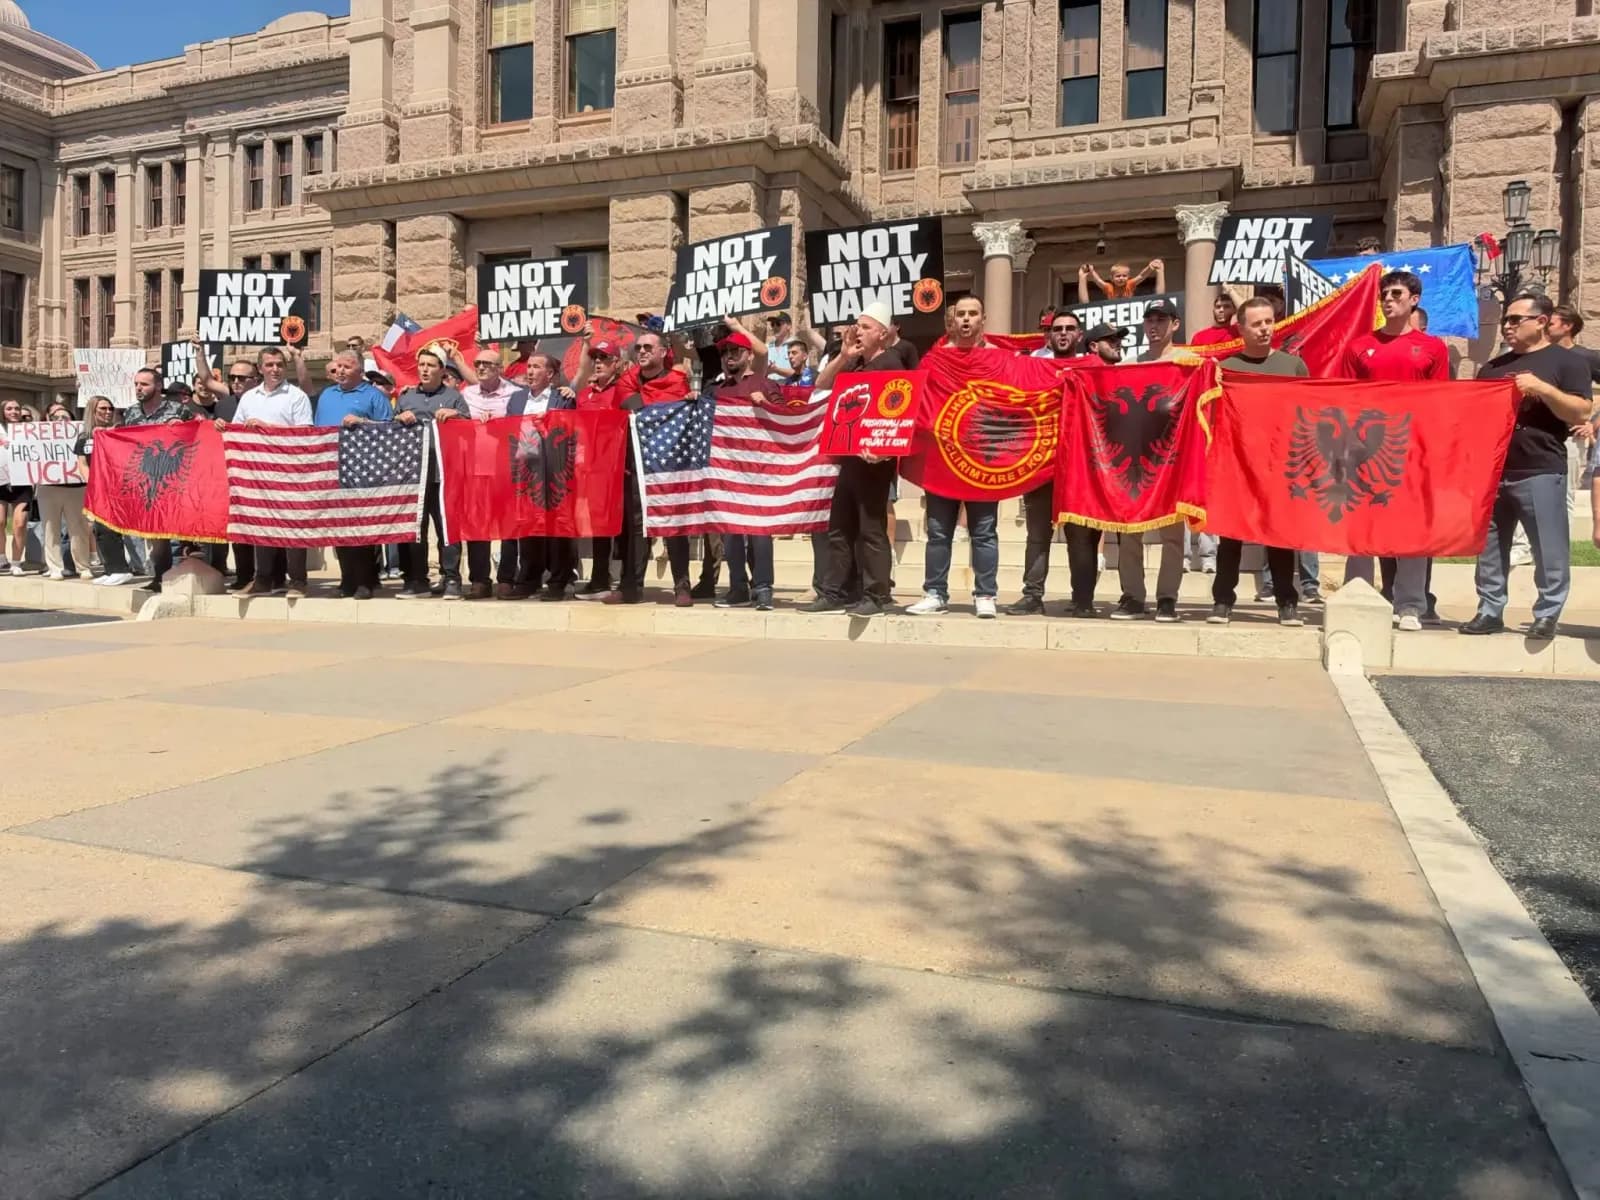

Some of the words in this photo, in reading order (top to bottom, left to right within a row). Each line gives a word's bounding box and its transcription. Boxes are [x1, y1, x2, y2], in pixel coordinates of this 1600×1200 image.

[827, 223, 919, 263] NOT
[1235, 217, 1312, 240] NOT
[693, 231, 770, 271] NOT
[1223, 239, 1258, 259] IN
[1260, 239, 1314, 260] MY
[216, 273, 291, 296] NOT
[494, 260, 569, 290] NOT
[685, 266, 719, 296] IN
[725, 255, 777, 287] MY
[820, 261, 861, 291] IN
[868, 253, 928, 286] MY
[208, 295, 241, 317] IN
[247, 296, 296, 317] MY
[487, 289, 520, 313] IN
[526, 284, 576, 310] MY
[677, 281, 761, 324] NAME
[200, 316, 281, 342] NAME
[480, 308, 561, 340] NAME
[168, 360, 187, 377] IN
[12, 443, 41, 462] HAS
